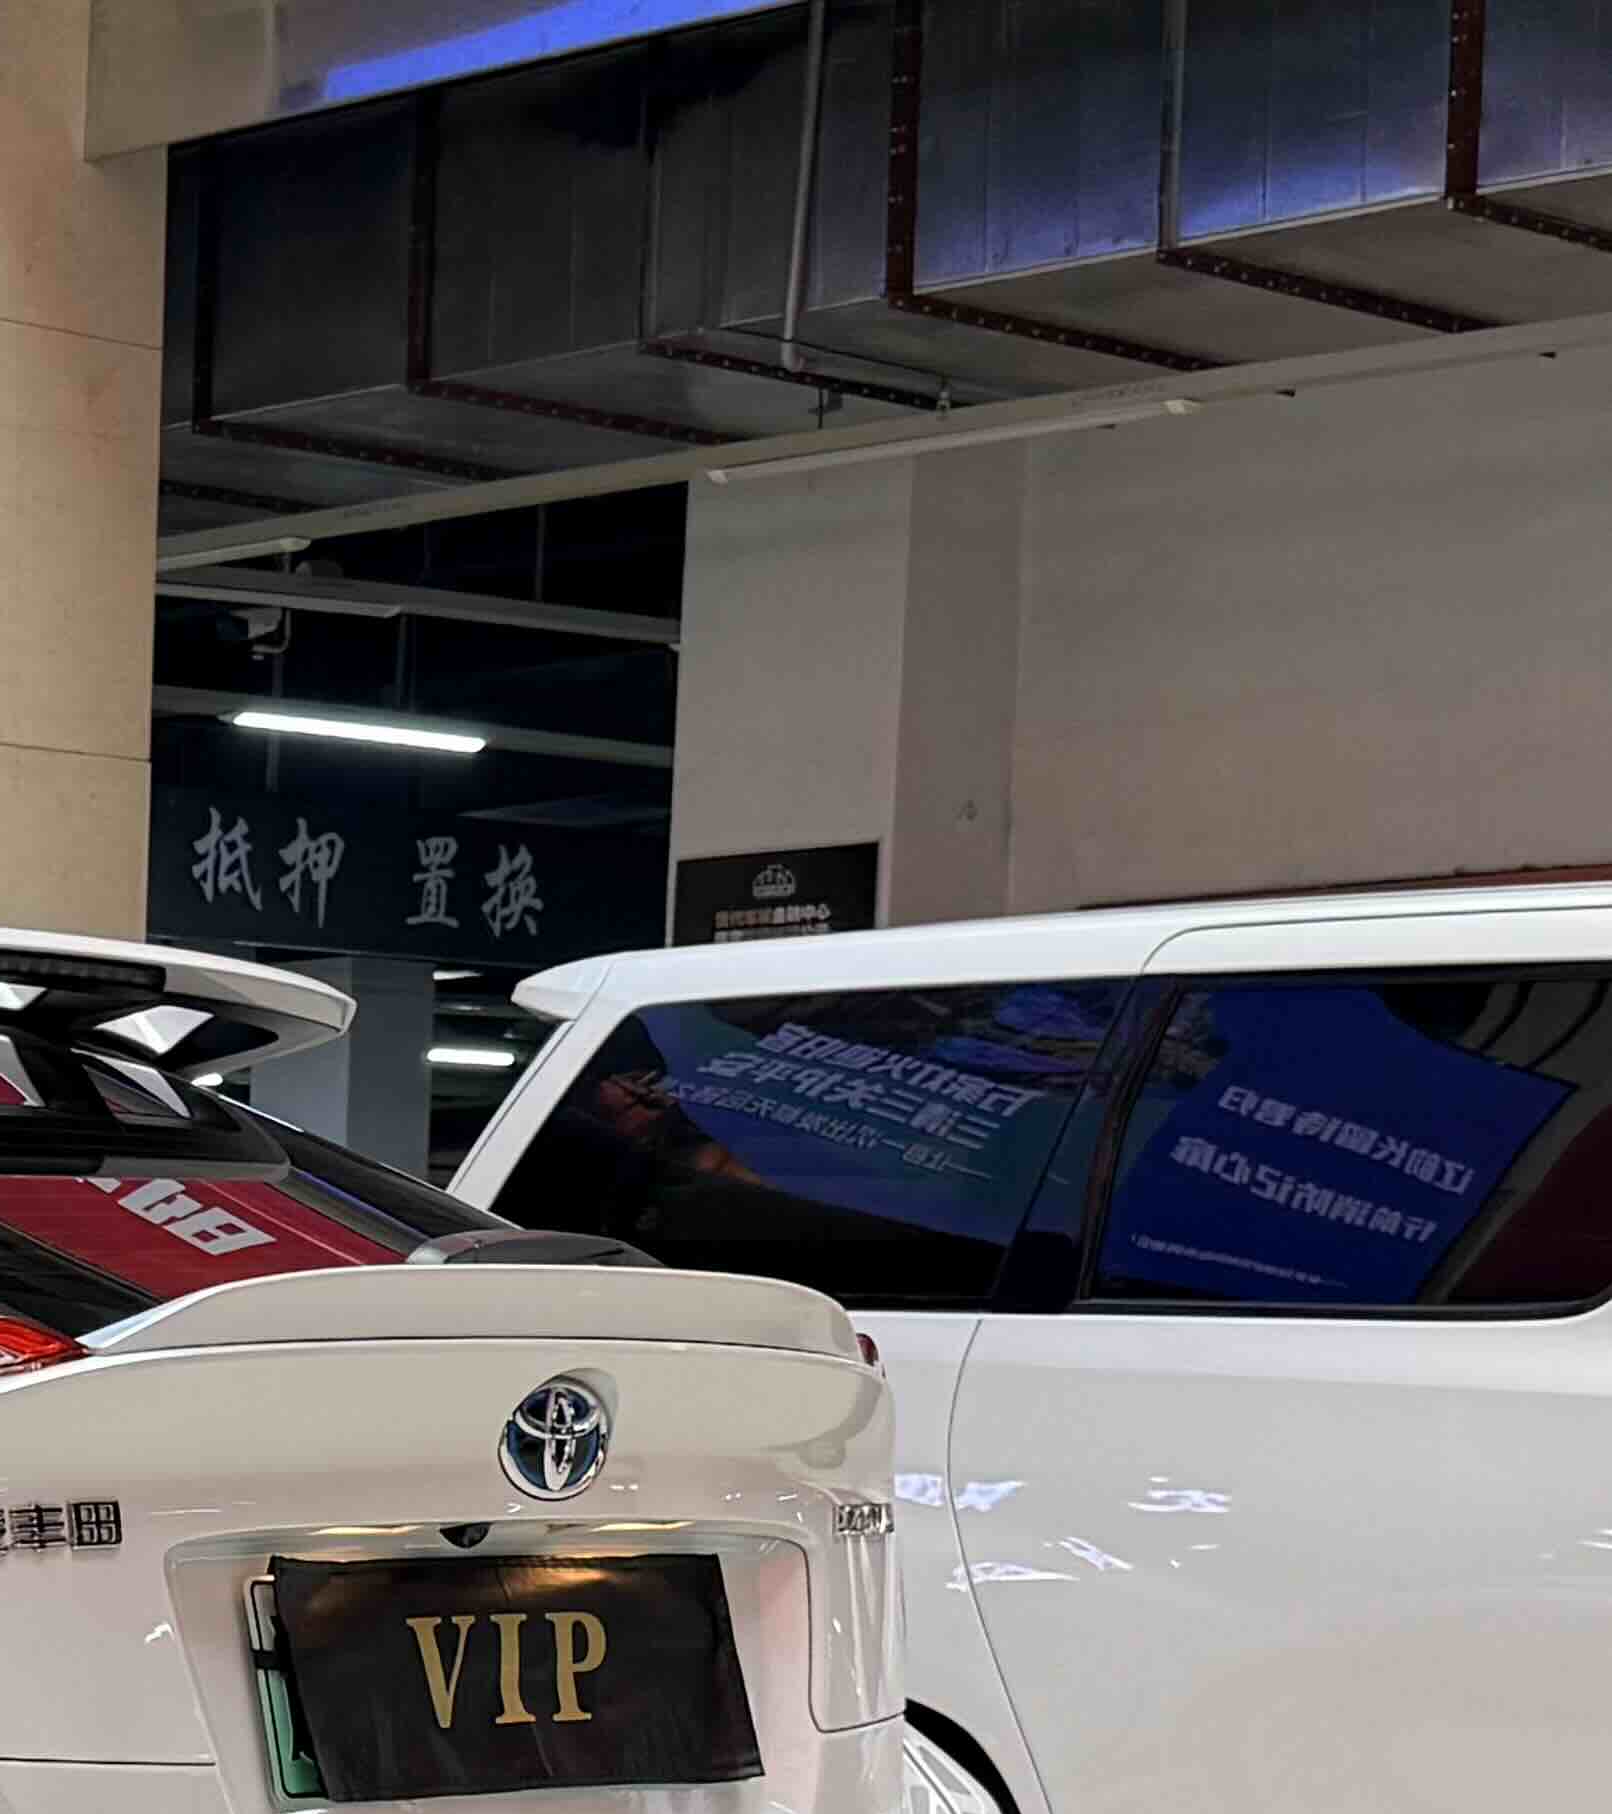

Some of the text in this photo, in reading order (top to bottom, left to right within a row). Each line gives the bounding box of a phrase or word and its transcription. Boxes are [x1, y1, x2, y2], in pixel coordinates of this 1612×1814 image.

[192, 804, 544, 938] 抵押 置换
[406, 1611, 607, 1729] VIP
